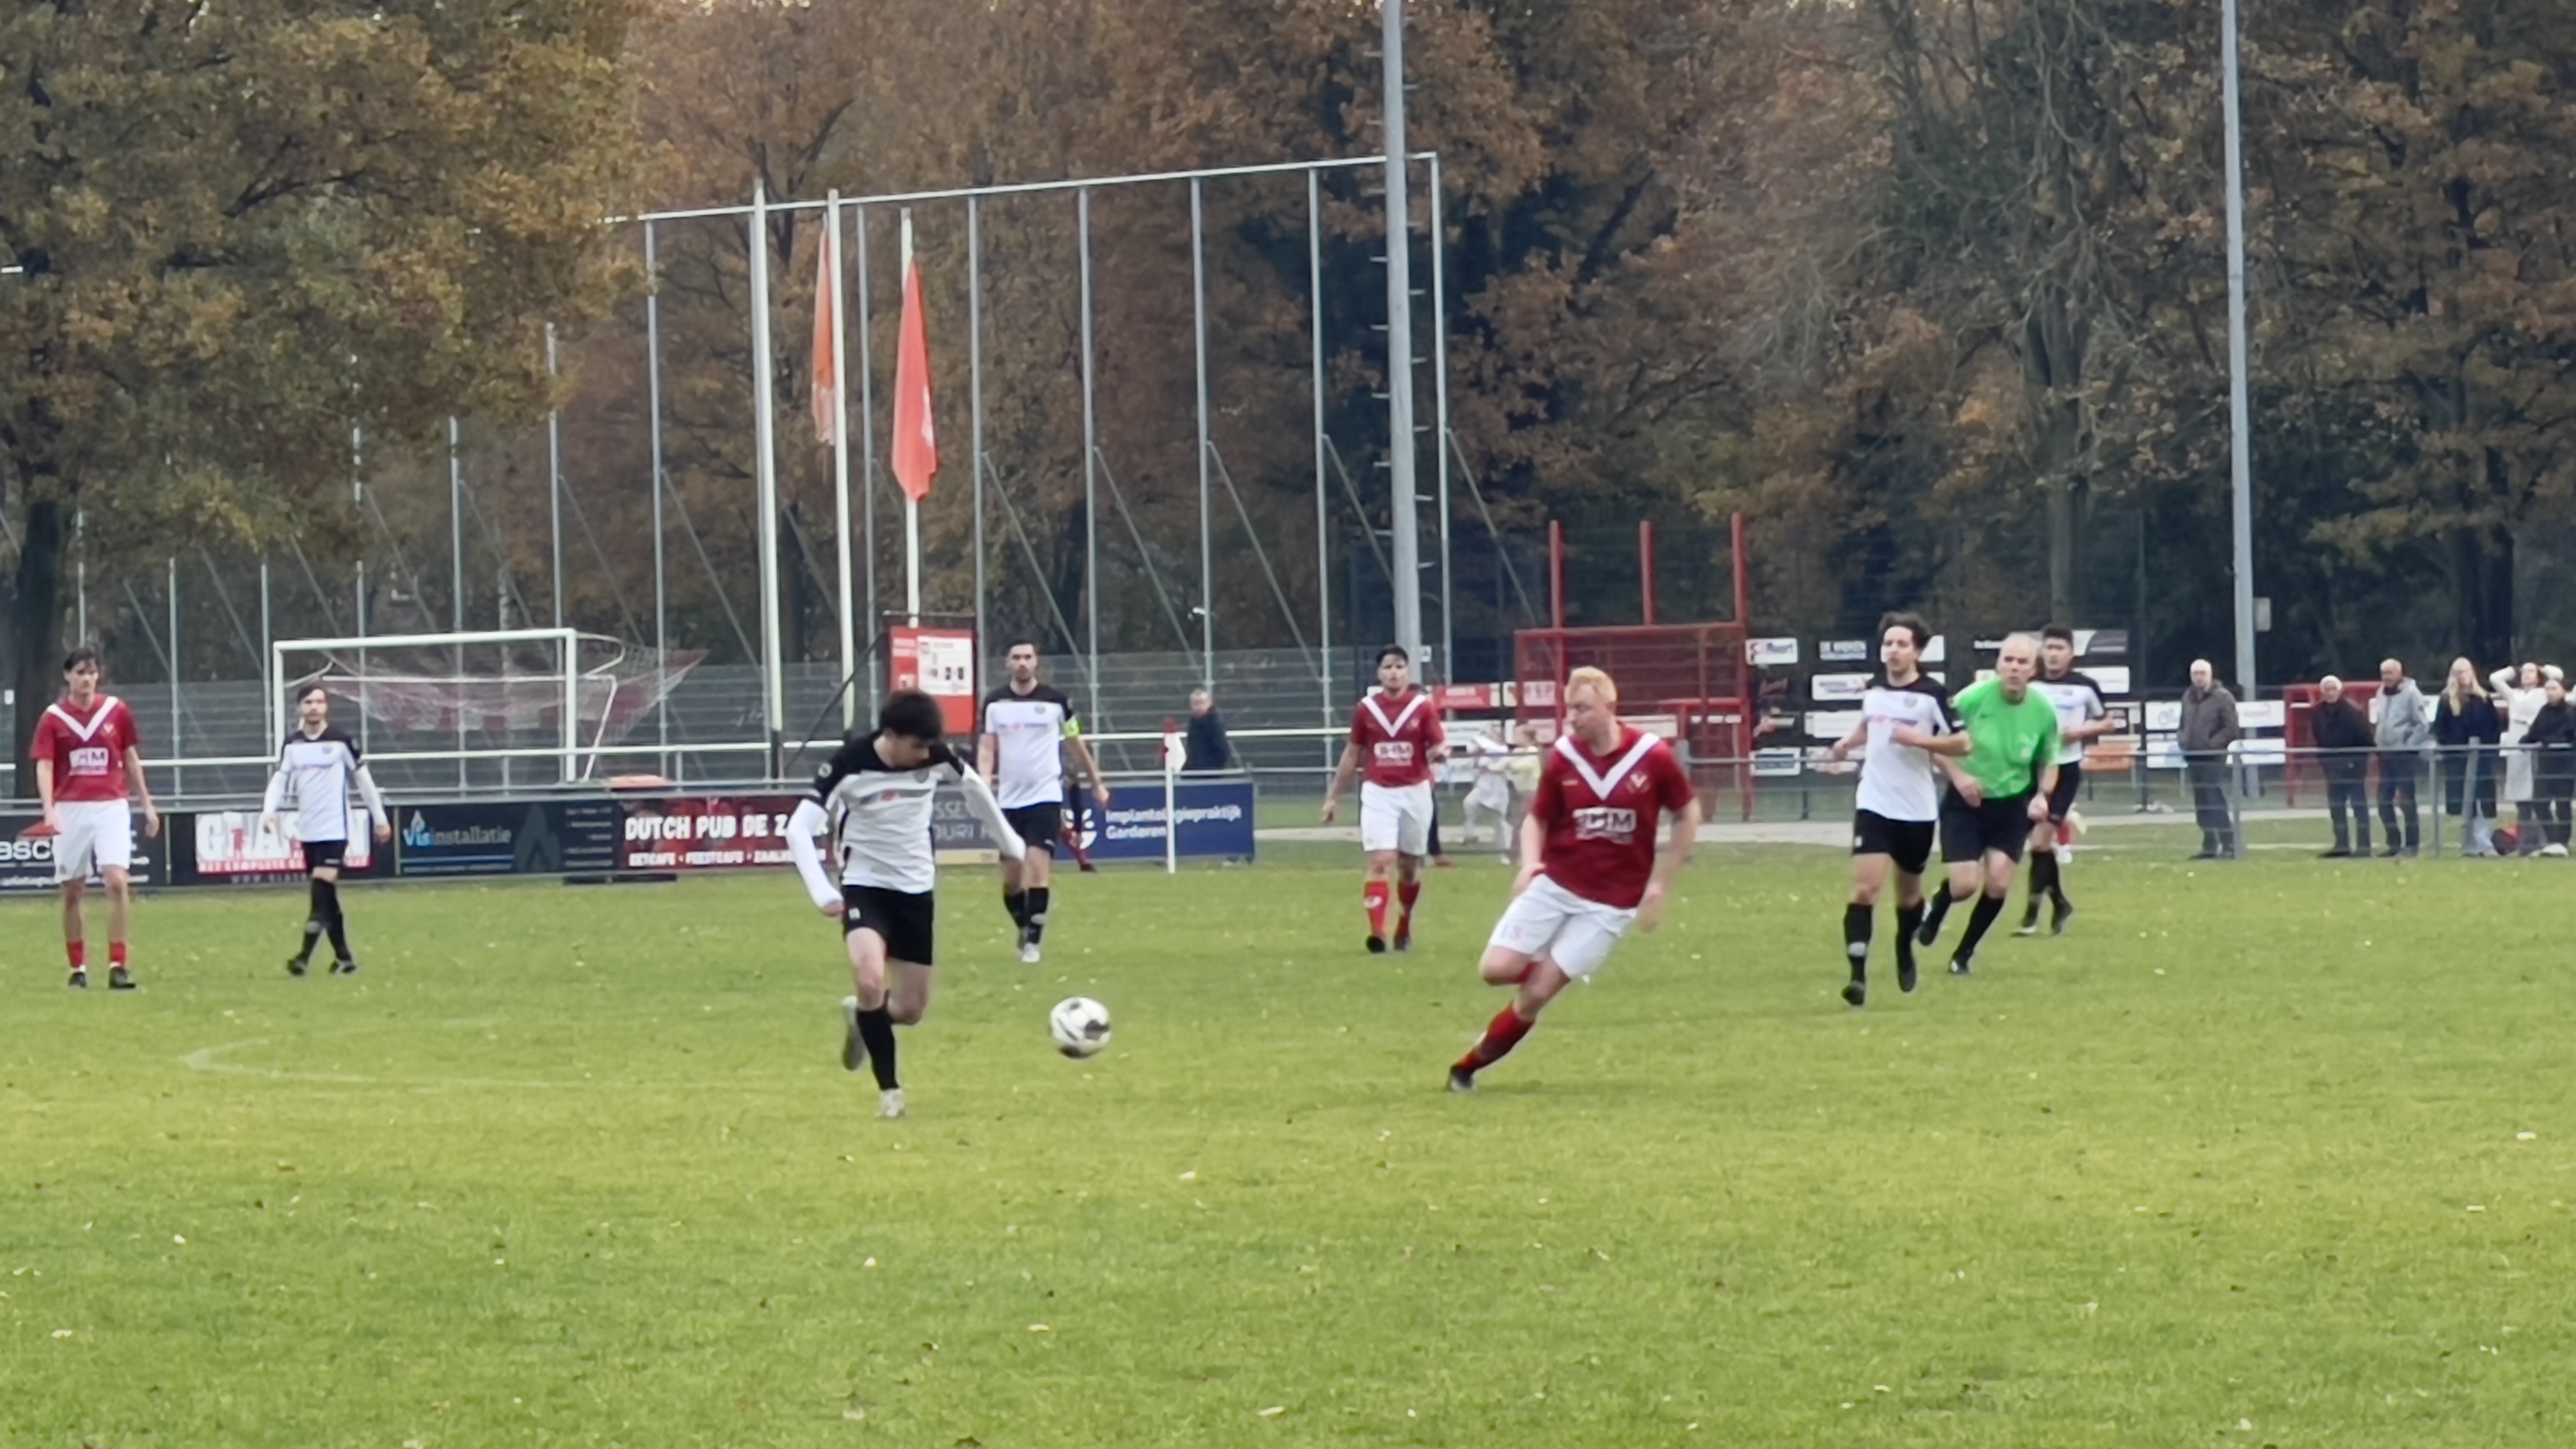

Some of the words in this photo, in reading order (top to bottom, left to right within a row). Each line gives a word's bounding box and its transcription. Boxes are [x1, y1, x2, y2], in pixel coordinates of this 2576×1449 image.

[625, 815, 691, 840] DUTCH
[696, 815, 737, 838] PUB
[742, 814, 768, 838] DE
